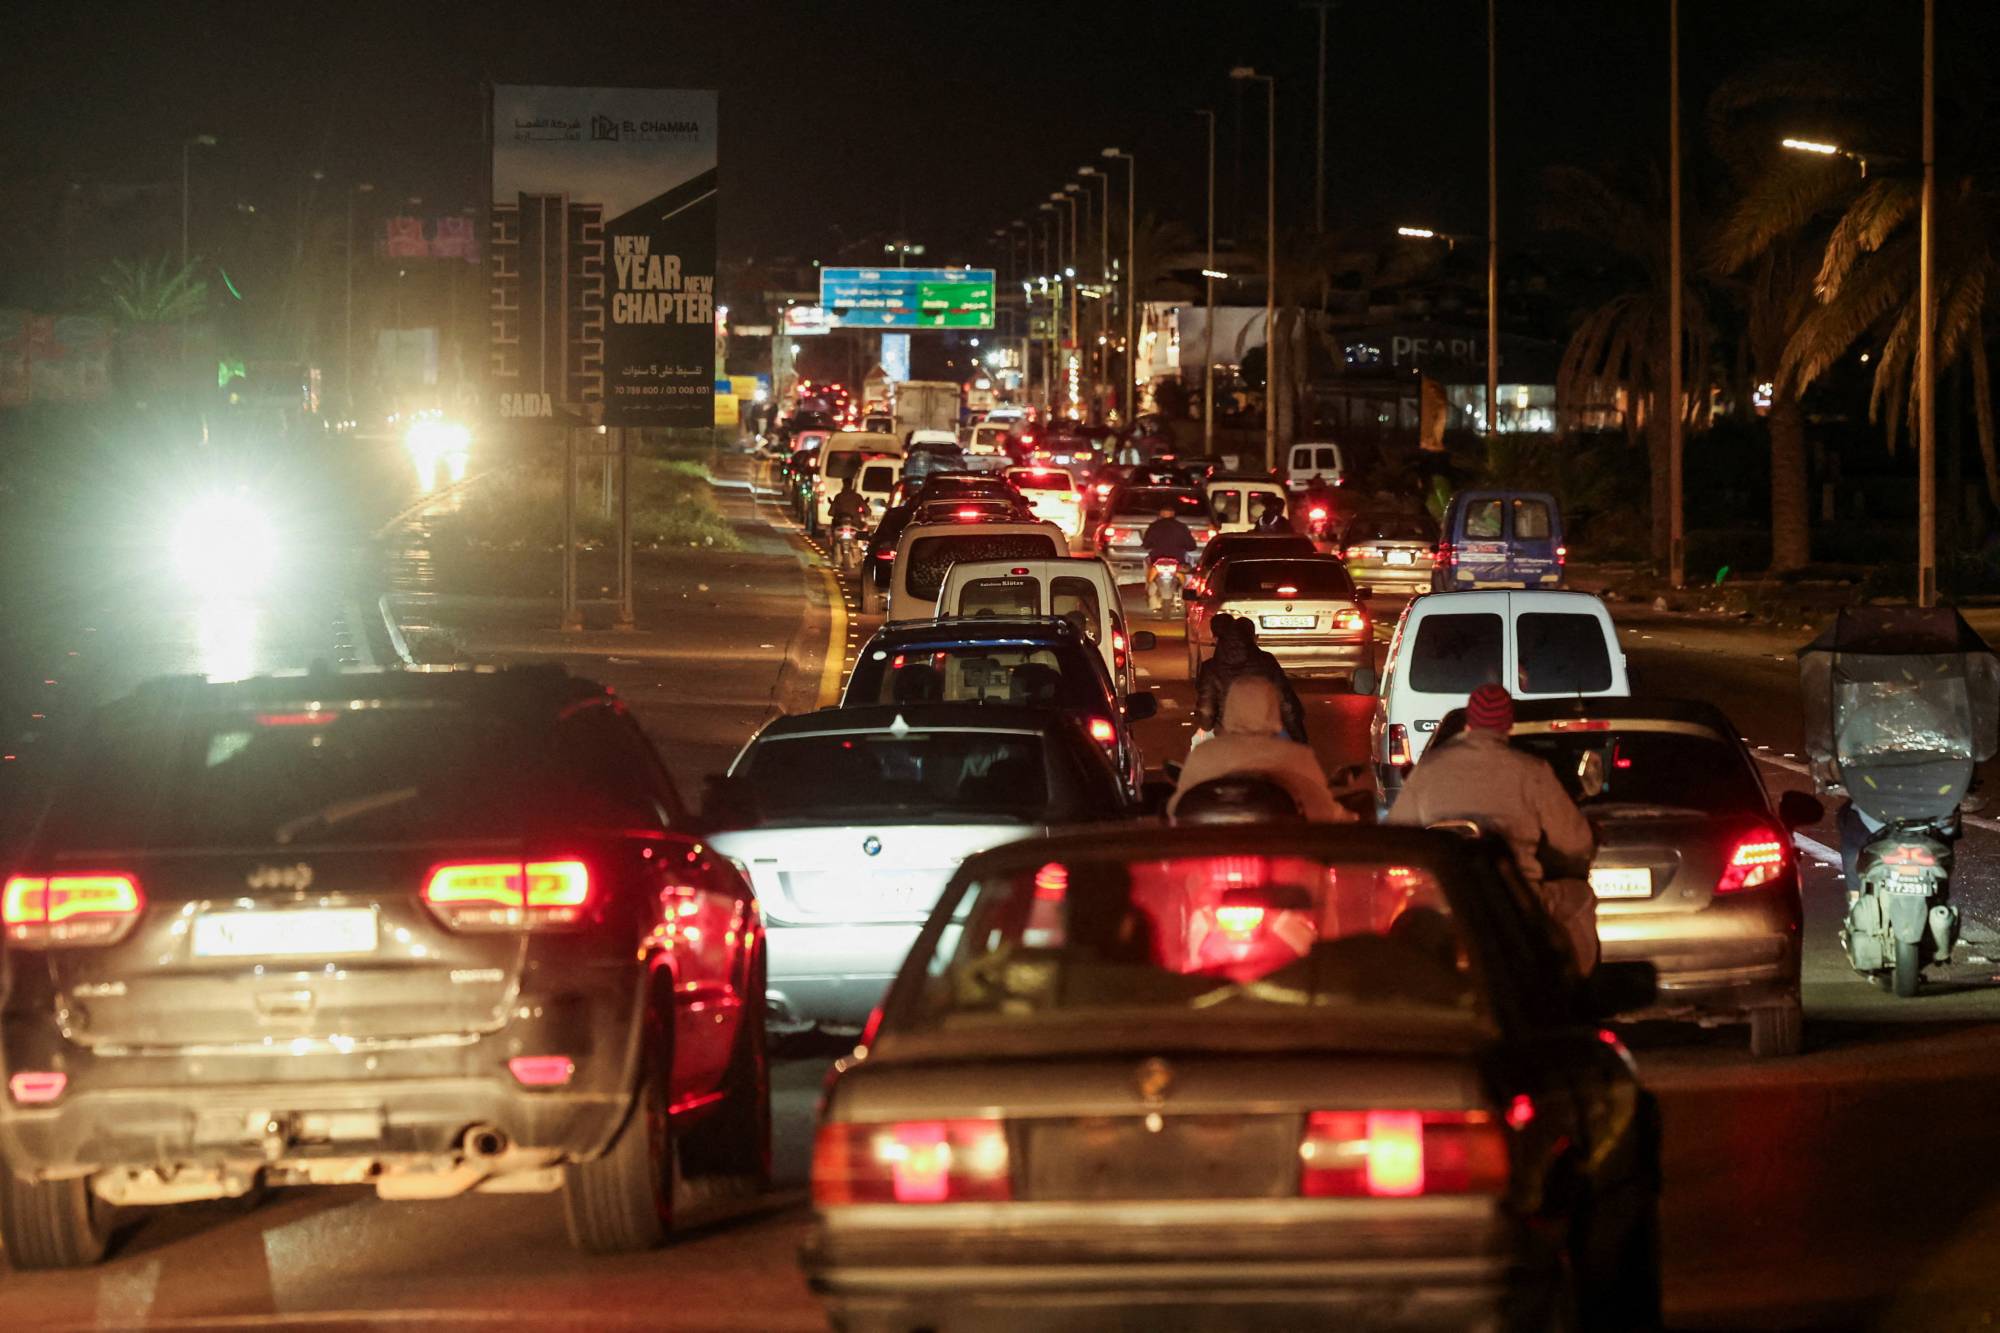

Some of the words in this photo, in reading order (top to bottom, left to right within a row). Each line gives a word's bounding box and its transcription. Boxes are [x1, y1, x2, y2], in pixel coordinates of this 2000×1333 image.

[623, 121, 638, 133] EL
[640, 121, 699, 133] CHAMMA
[613, 236, 650, 255] NEW
[613, 254, 681, 290] YEAR
[684, 276, 714, 294] NEW
[612, 292, 713, 324] CHAPTER
[650, 364, 657, 375] 5
[499, 393, 553, 417] SAIDA
